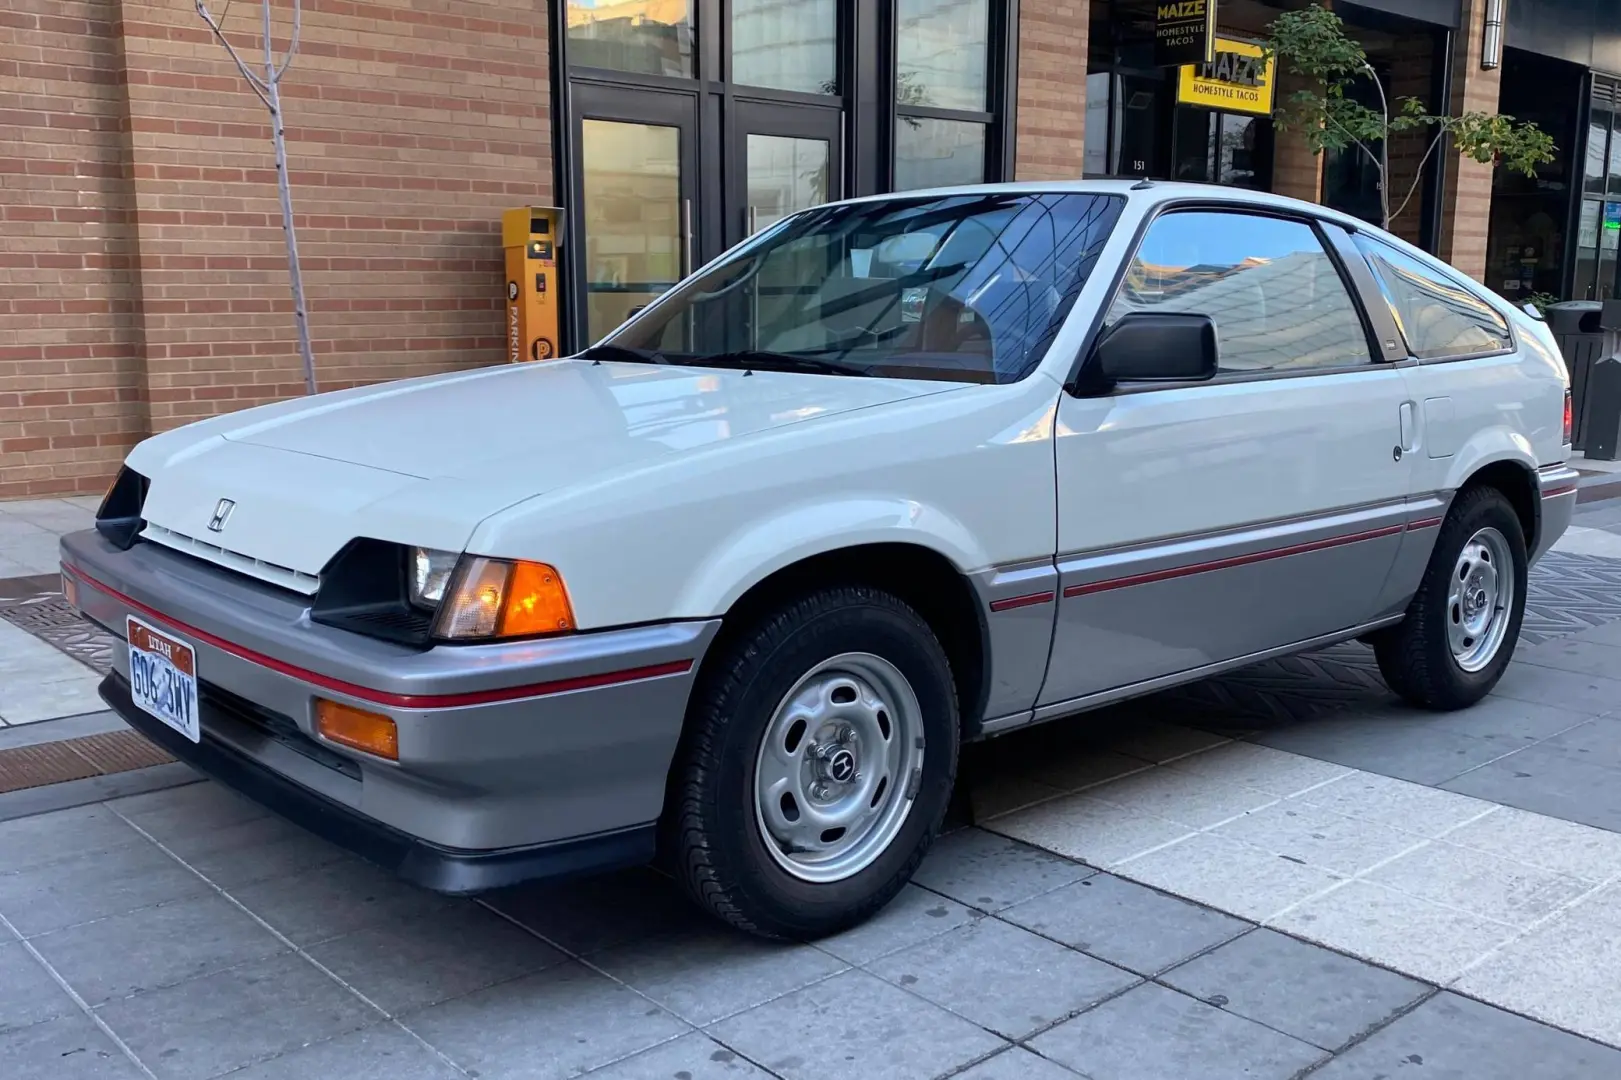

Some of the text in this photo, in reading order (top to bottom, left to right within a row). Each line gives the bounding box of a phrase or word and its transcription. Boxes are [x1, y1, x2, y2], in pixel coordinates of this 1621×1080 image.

[1157, 0, 1205, 20] MAIZE
[1156, 24, 1204, 38] HOMESTYLE
[1166, 36, 1194, 47] TACOS
[1193, 84, 1259, 101] HOMESTYLE TACOS
[1133, 160, 1145, 170] 151
[147, 635, 172, 659] UTAH
